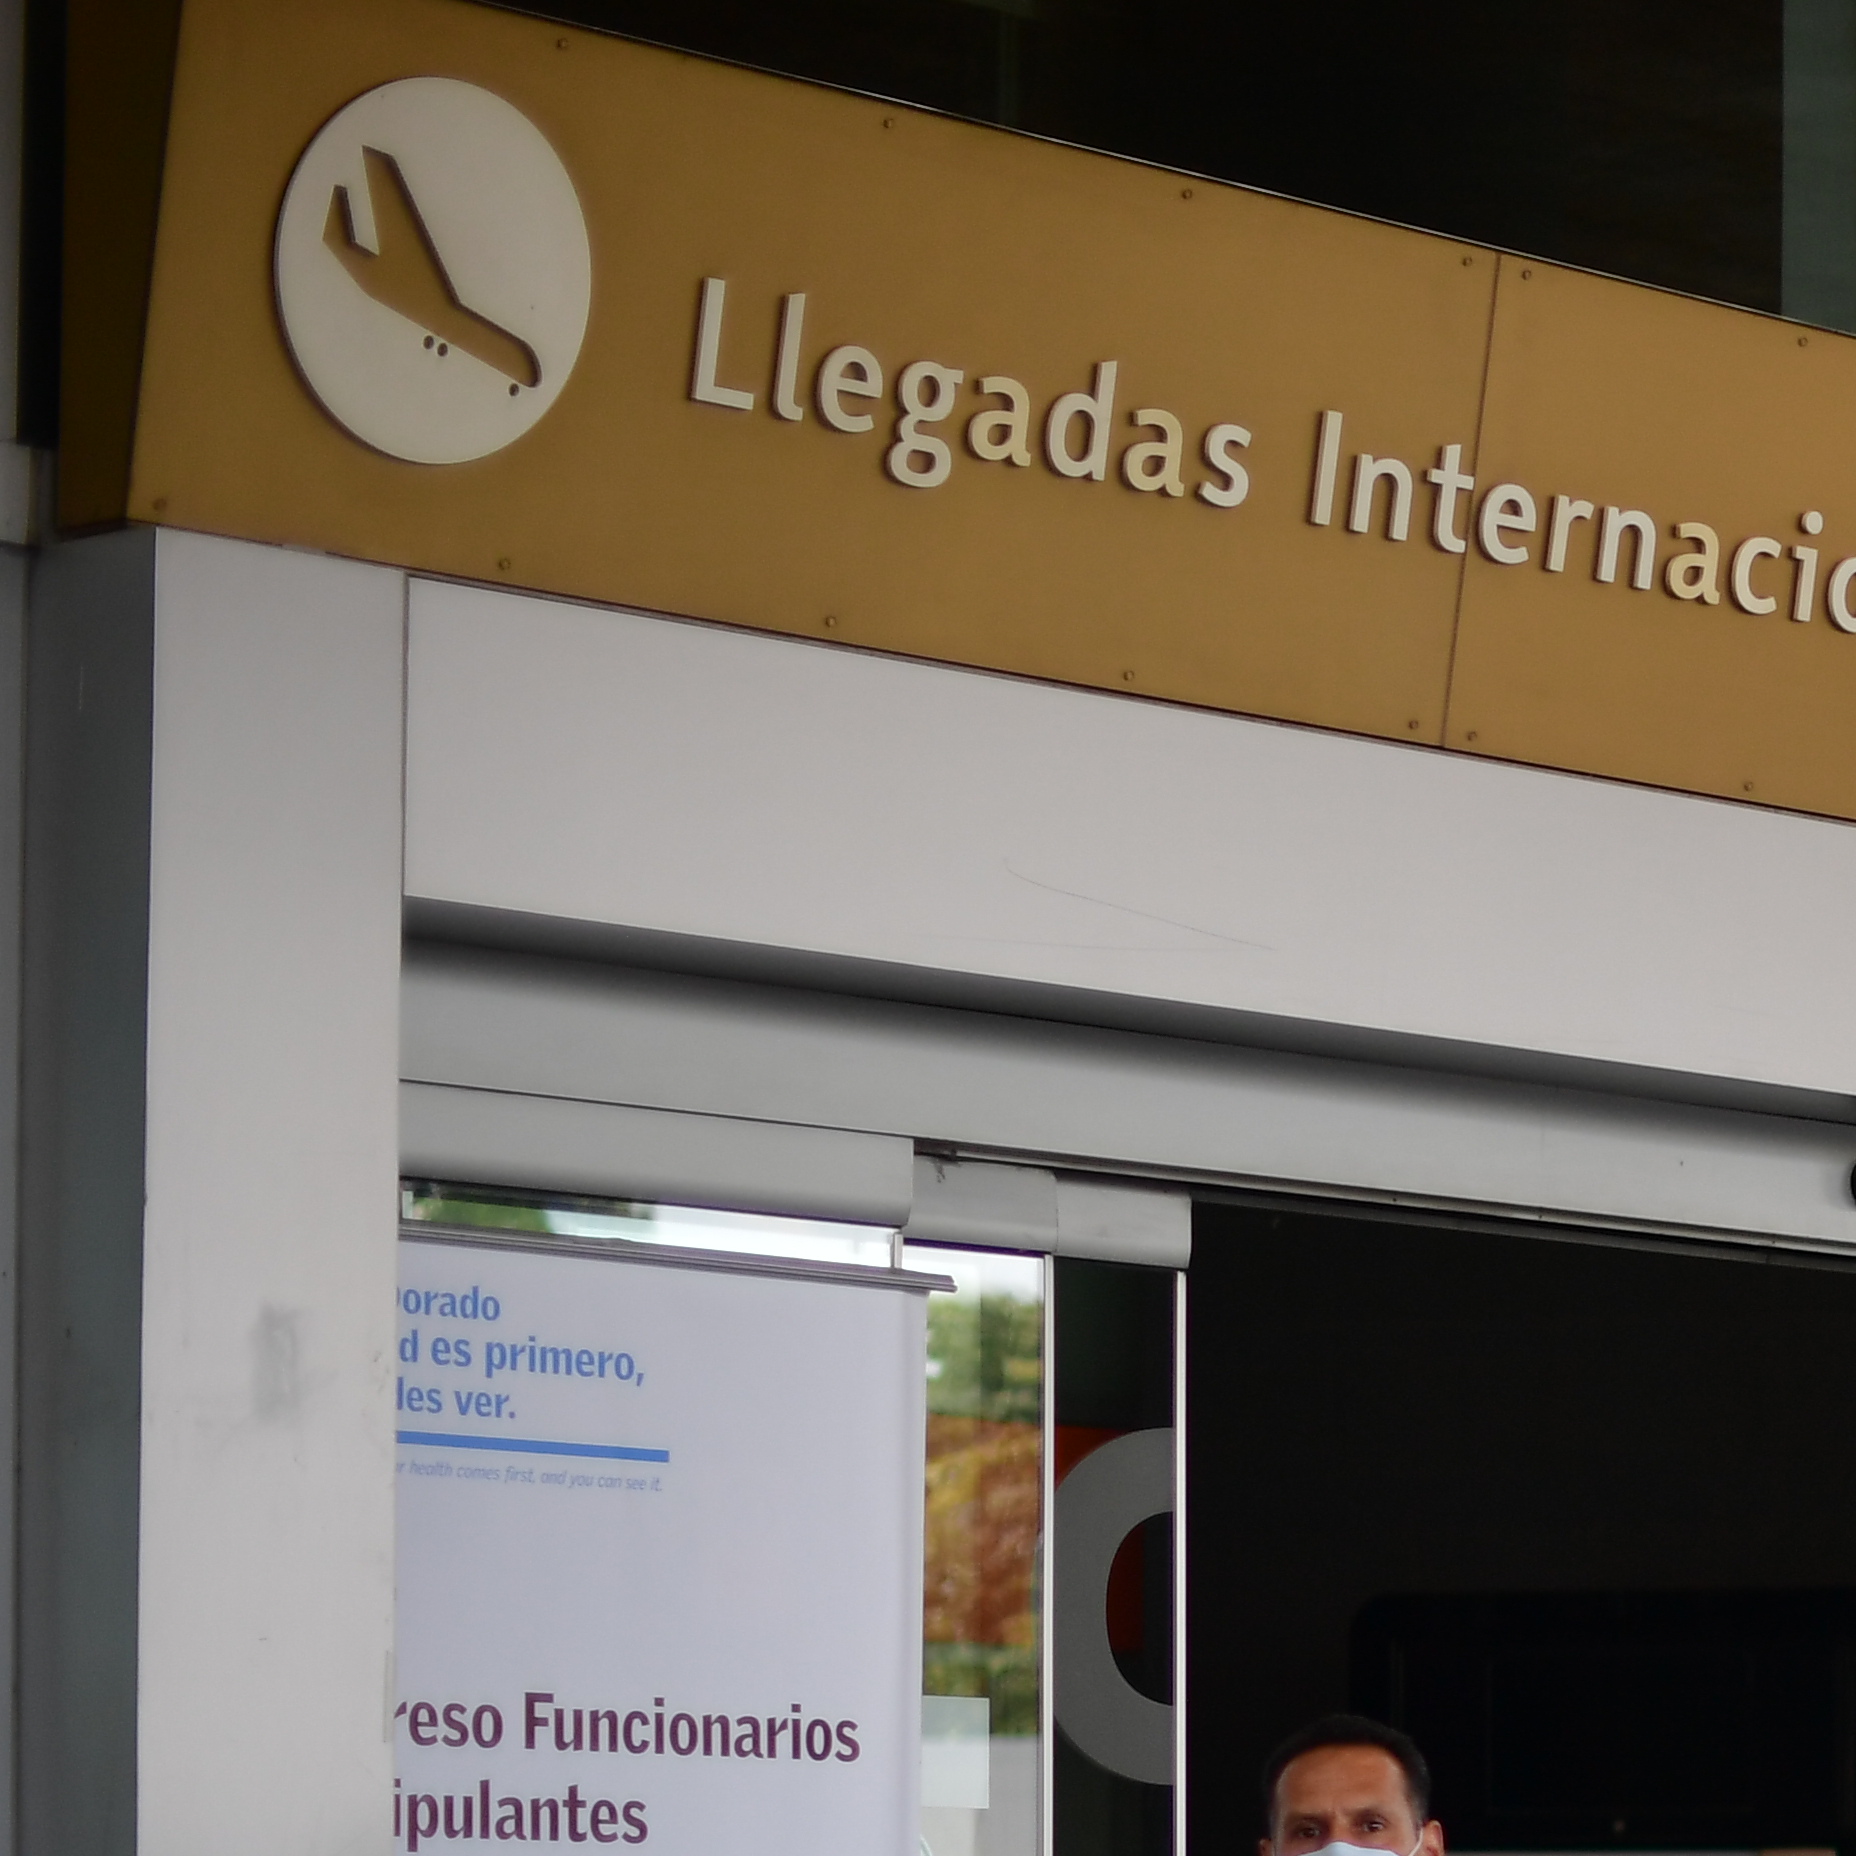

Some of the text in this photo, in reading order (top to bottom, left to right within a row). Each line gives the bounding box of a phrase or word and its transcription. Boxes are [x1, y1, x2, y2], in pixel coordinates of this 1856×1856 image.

[691, 276, 1252, 510] Llegadas
[396, 1285, 500, 1321] orado
[431, 1335, 472, 1367] es
[485, 1335, 644, 1387] primero,
[454, 1389, 516, 1419] ver.
[409, 1460, 453, 1479] health
[457, 1465, 500, 1481] comes
[540, 1470, 567, 1485] and
[568, 1473, 594, 1490] you
[598, 1475, 622, 1489] can
[626, 1478, 647, 1491] see
[522, 1690, 861, 1764] Funcionarios
